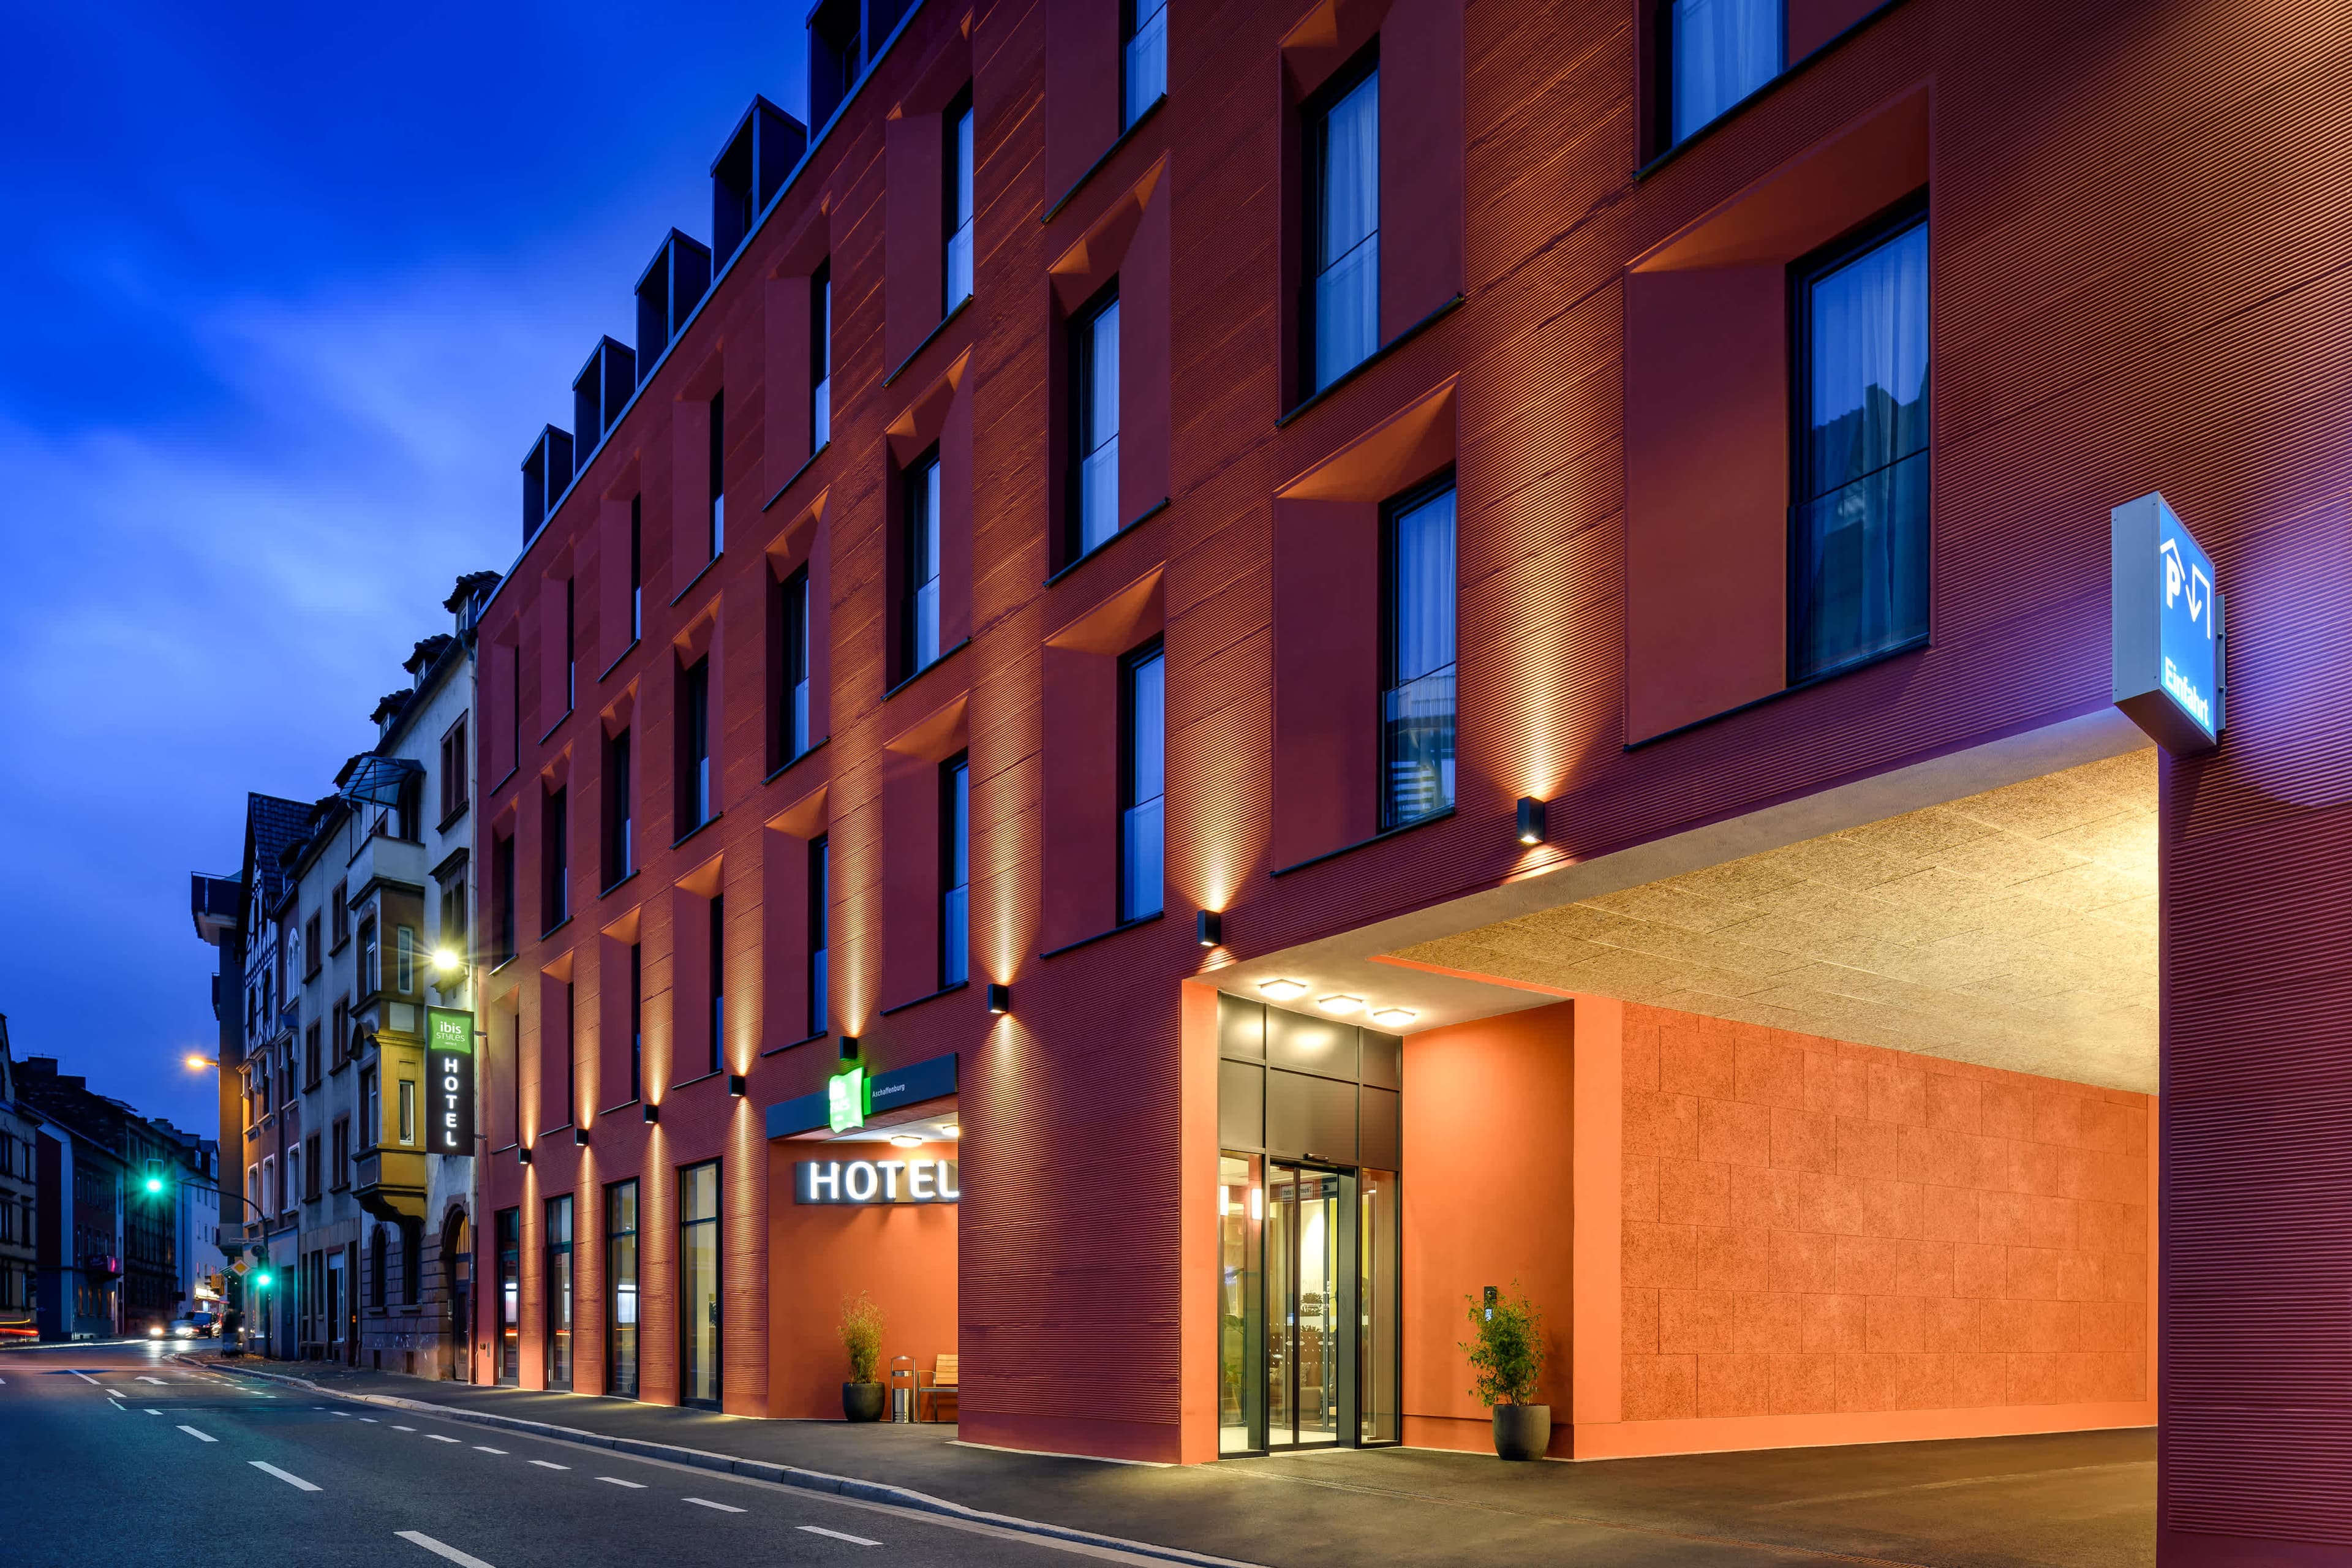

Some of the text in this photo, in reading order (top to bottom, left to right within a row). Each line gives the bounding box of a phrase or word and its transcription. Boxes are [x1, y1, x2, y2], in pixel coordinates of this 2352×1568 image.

[2166, 554, 2181, 609] P
[2165, 656, 2209, 726] Einfahrt
[440, 1021, 462, 1034] ibis
[445, 1058, 458, 1146] HOTEL
[872, 1084, 905, 1098] Aschaffenburg
[810, 1159, 959, 1200] HOTEL
